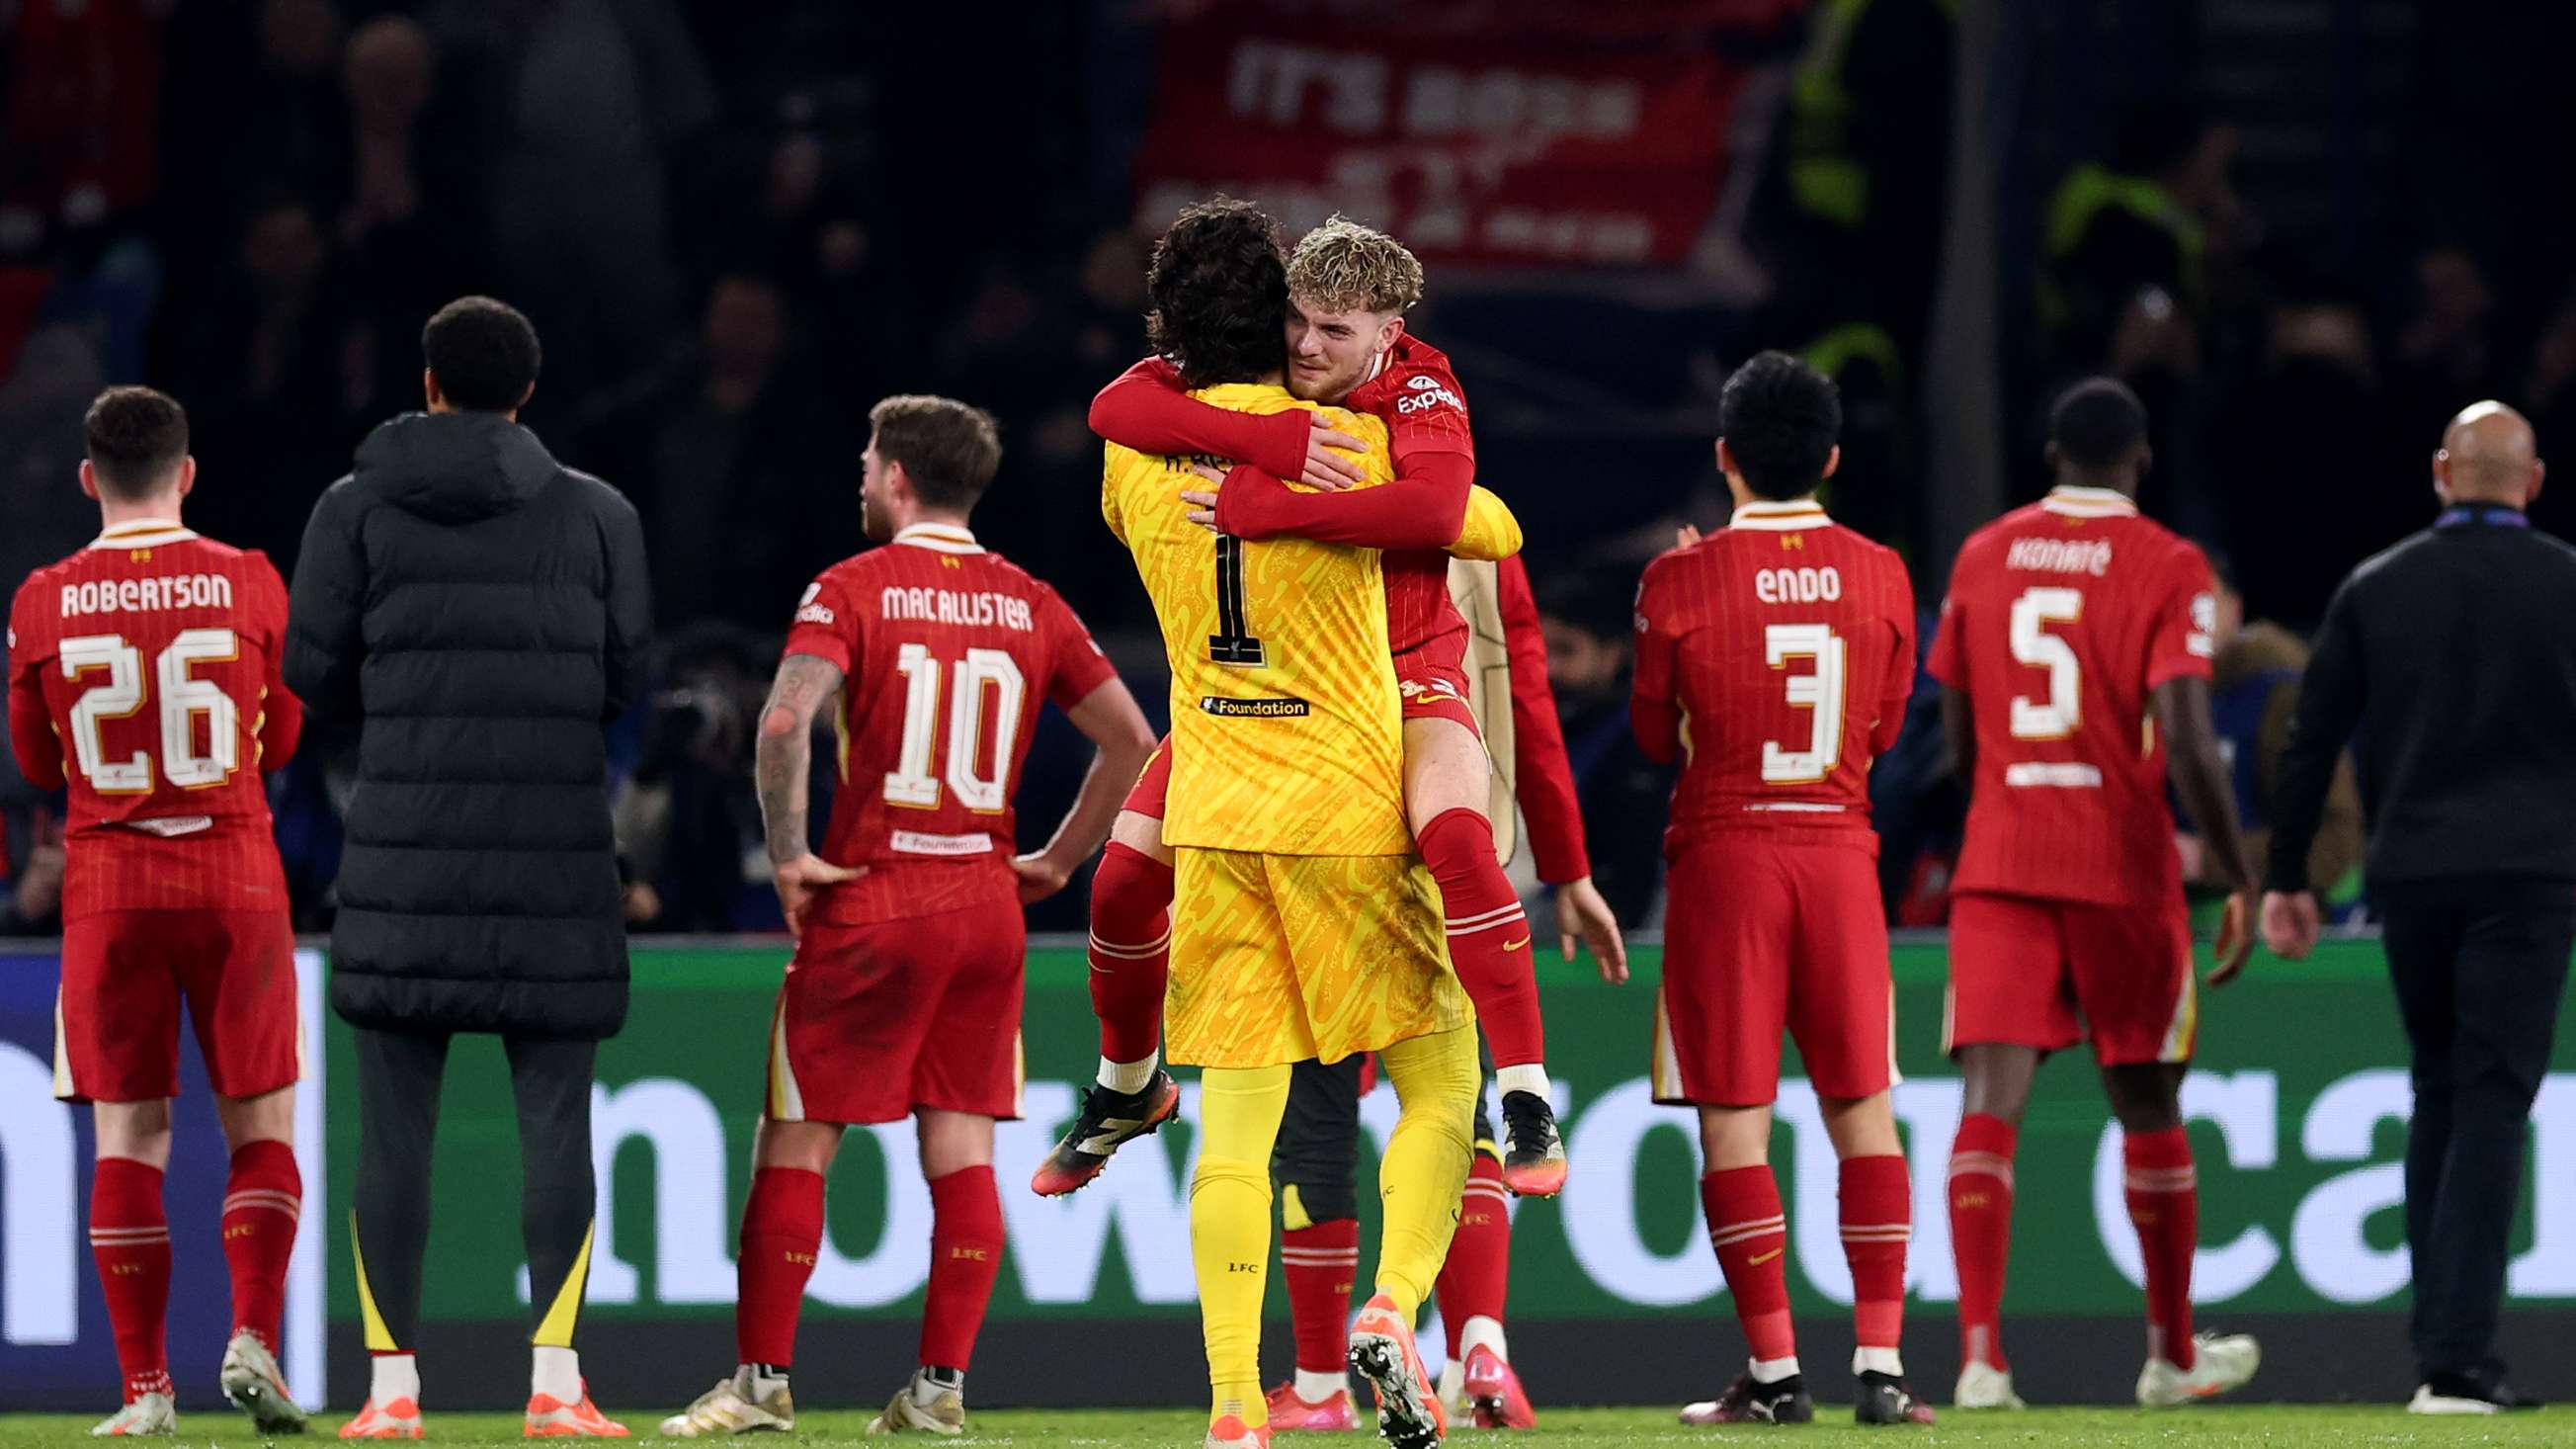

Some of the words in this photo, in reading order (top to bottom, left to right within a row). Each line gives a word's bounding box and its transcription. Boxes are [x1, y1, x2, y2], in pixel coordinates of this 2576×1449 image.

[61, 573, 232, 619] ROBERTSON
[1208, 528, 1268, 668] 1
[1755, 566, 1842, 604] ENDO
[2010, 586, 2082, 740] 5
[59, 628, 240, 796] 26
[1218, 699, 1305, 716] Foundation
[1761, 623, 1848, 784] 3
[882, 642, 1027, 814] 10
[785, 1251, 815, 1266] LFC
[952, 1247, 986, 1262] LFC
[1227, 1262, 1260, 1274] LFC
